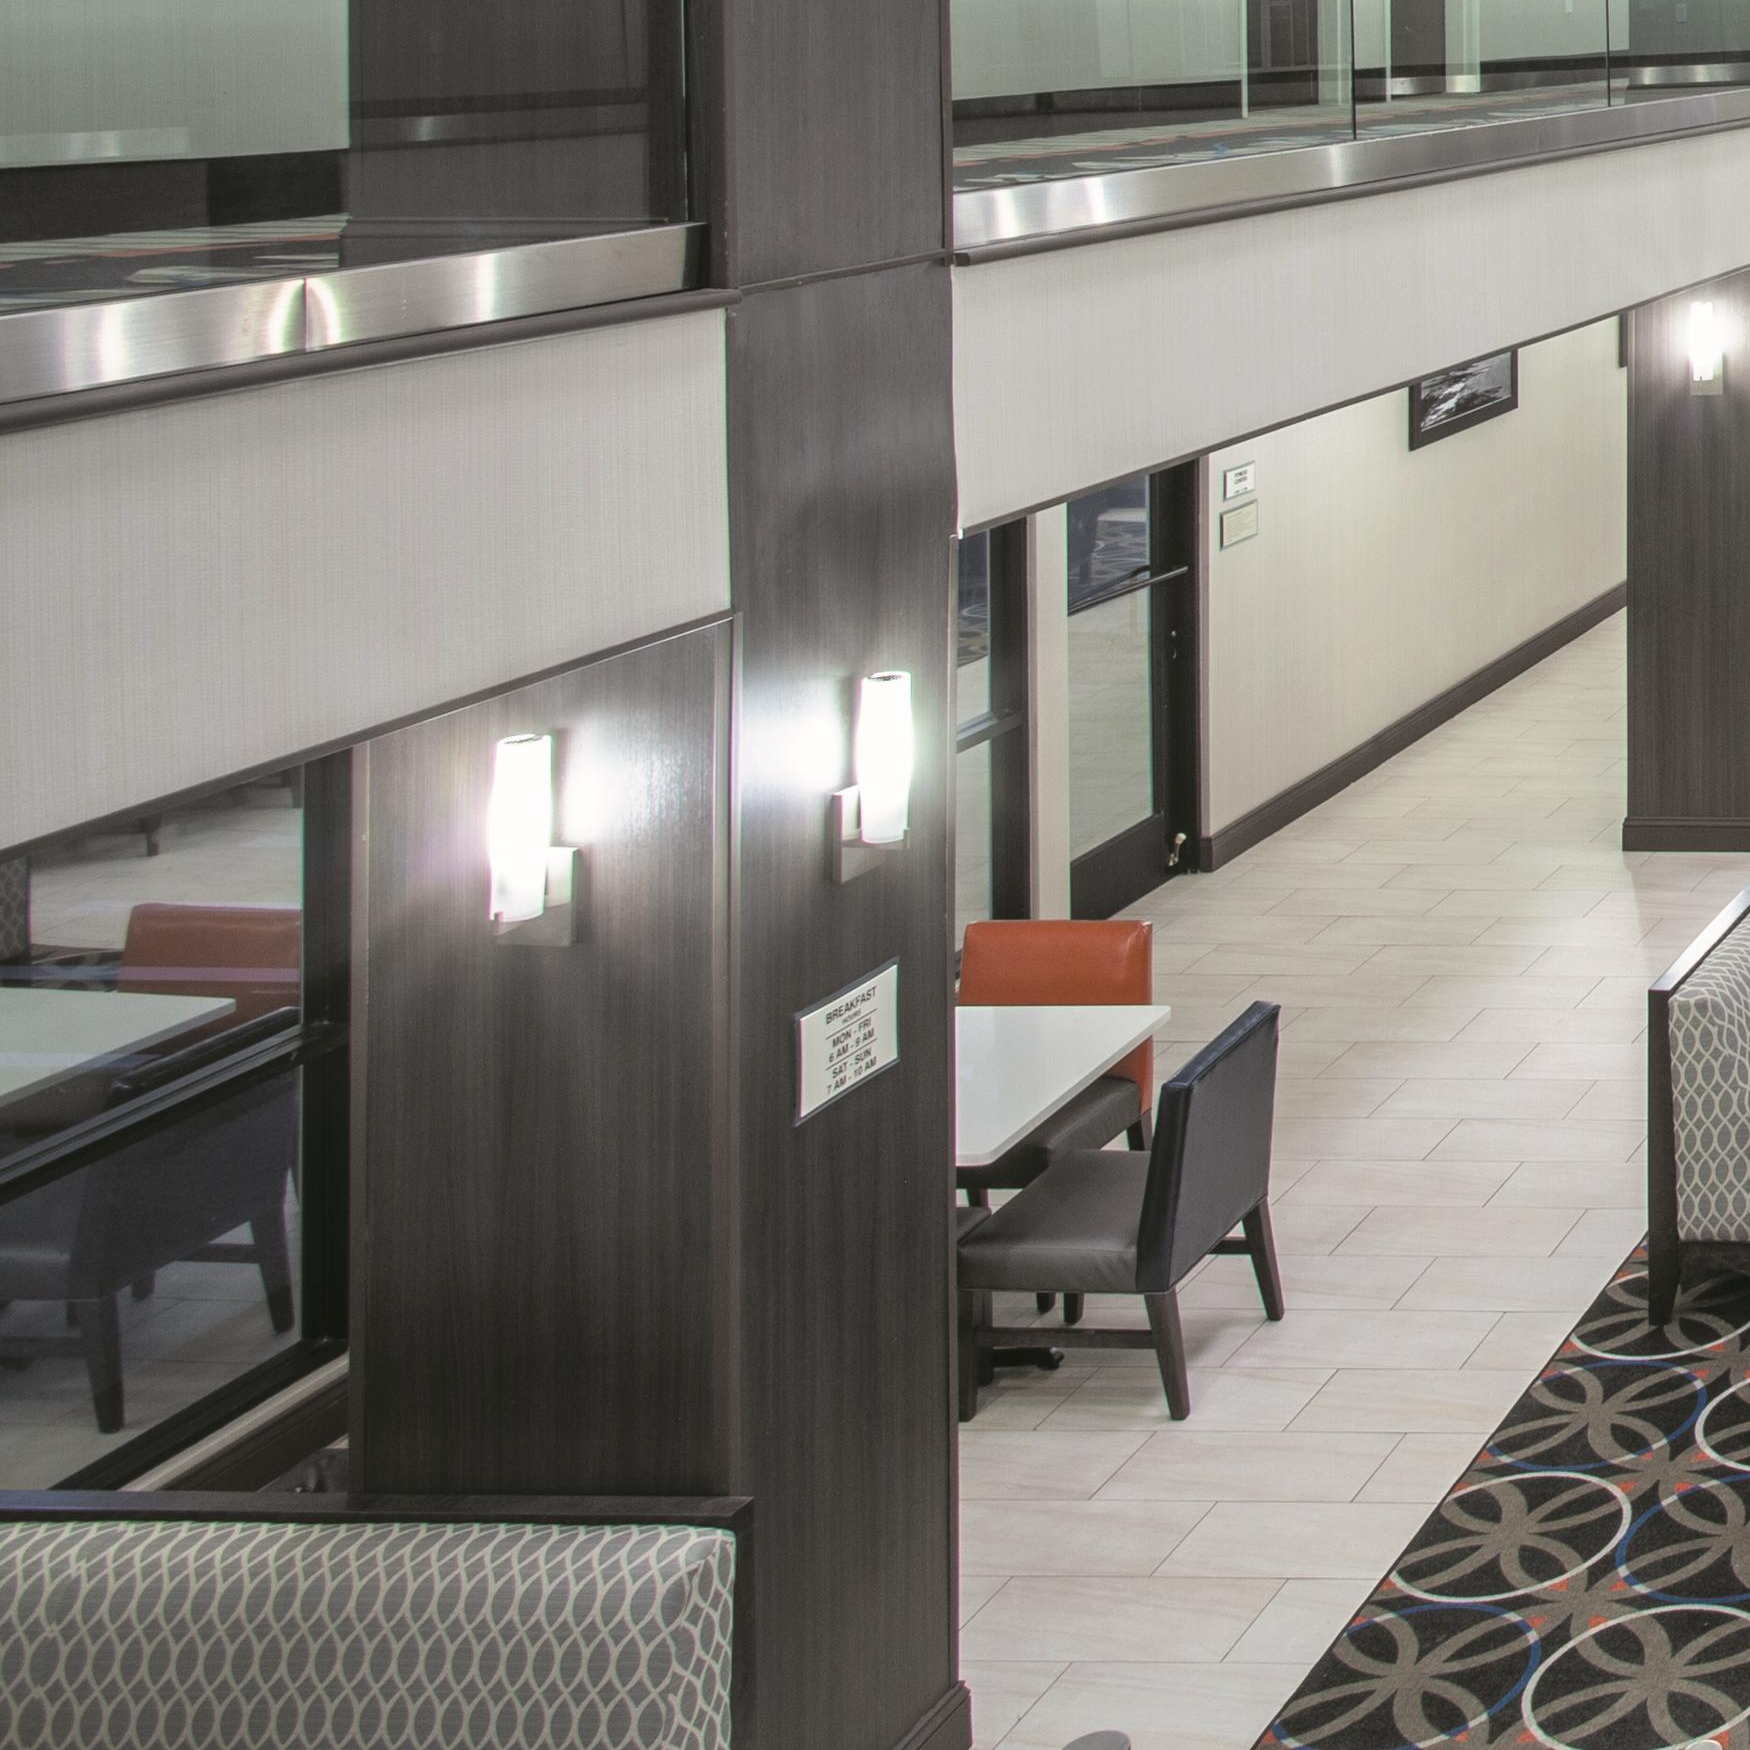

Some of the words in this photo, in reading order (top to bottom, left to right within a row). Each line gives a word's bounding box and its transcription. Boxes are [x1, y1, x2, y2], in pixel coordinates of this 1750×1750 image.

[825, 986, 877, 1025] BREAKFAST
[828, 1053, 834, 1063] 6
[836, 1044, 849, 1058] AM
[862, 1028, 875, 1042] AM
[832, 1029, 852, 1048] MON
[858, 1017, 872, 1032] FRI
[826, 1084, 832, 1095] 7
[834, 1075, 847, 1090] AM
[854, 1065, 863, 1077] 10
[865, 1056, 877, 1070] AM
[832, 1061, 848, 1079] SAT
[855, 1047, 872, 1065] SUN
